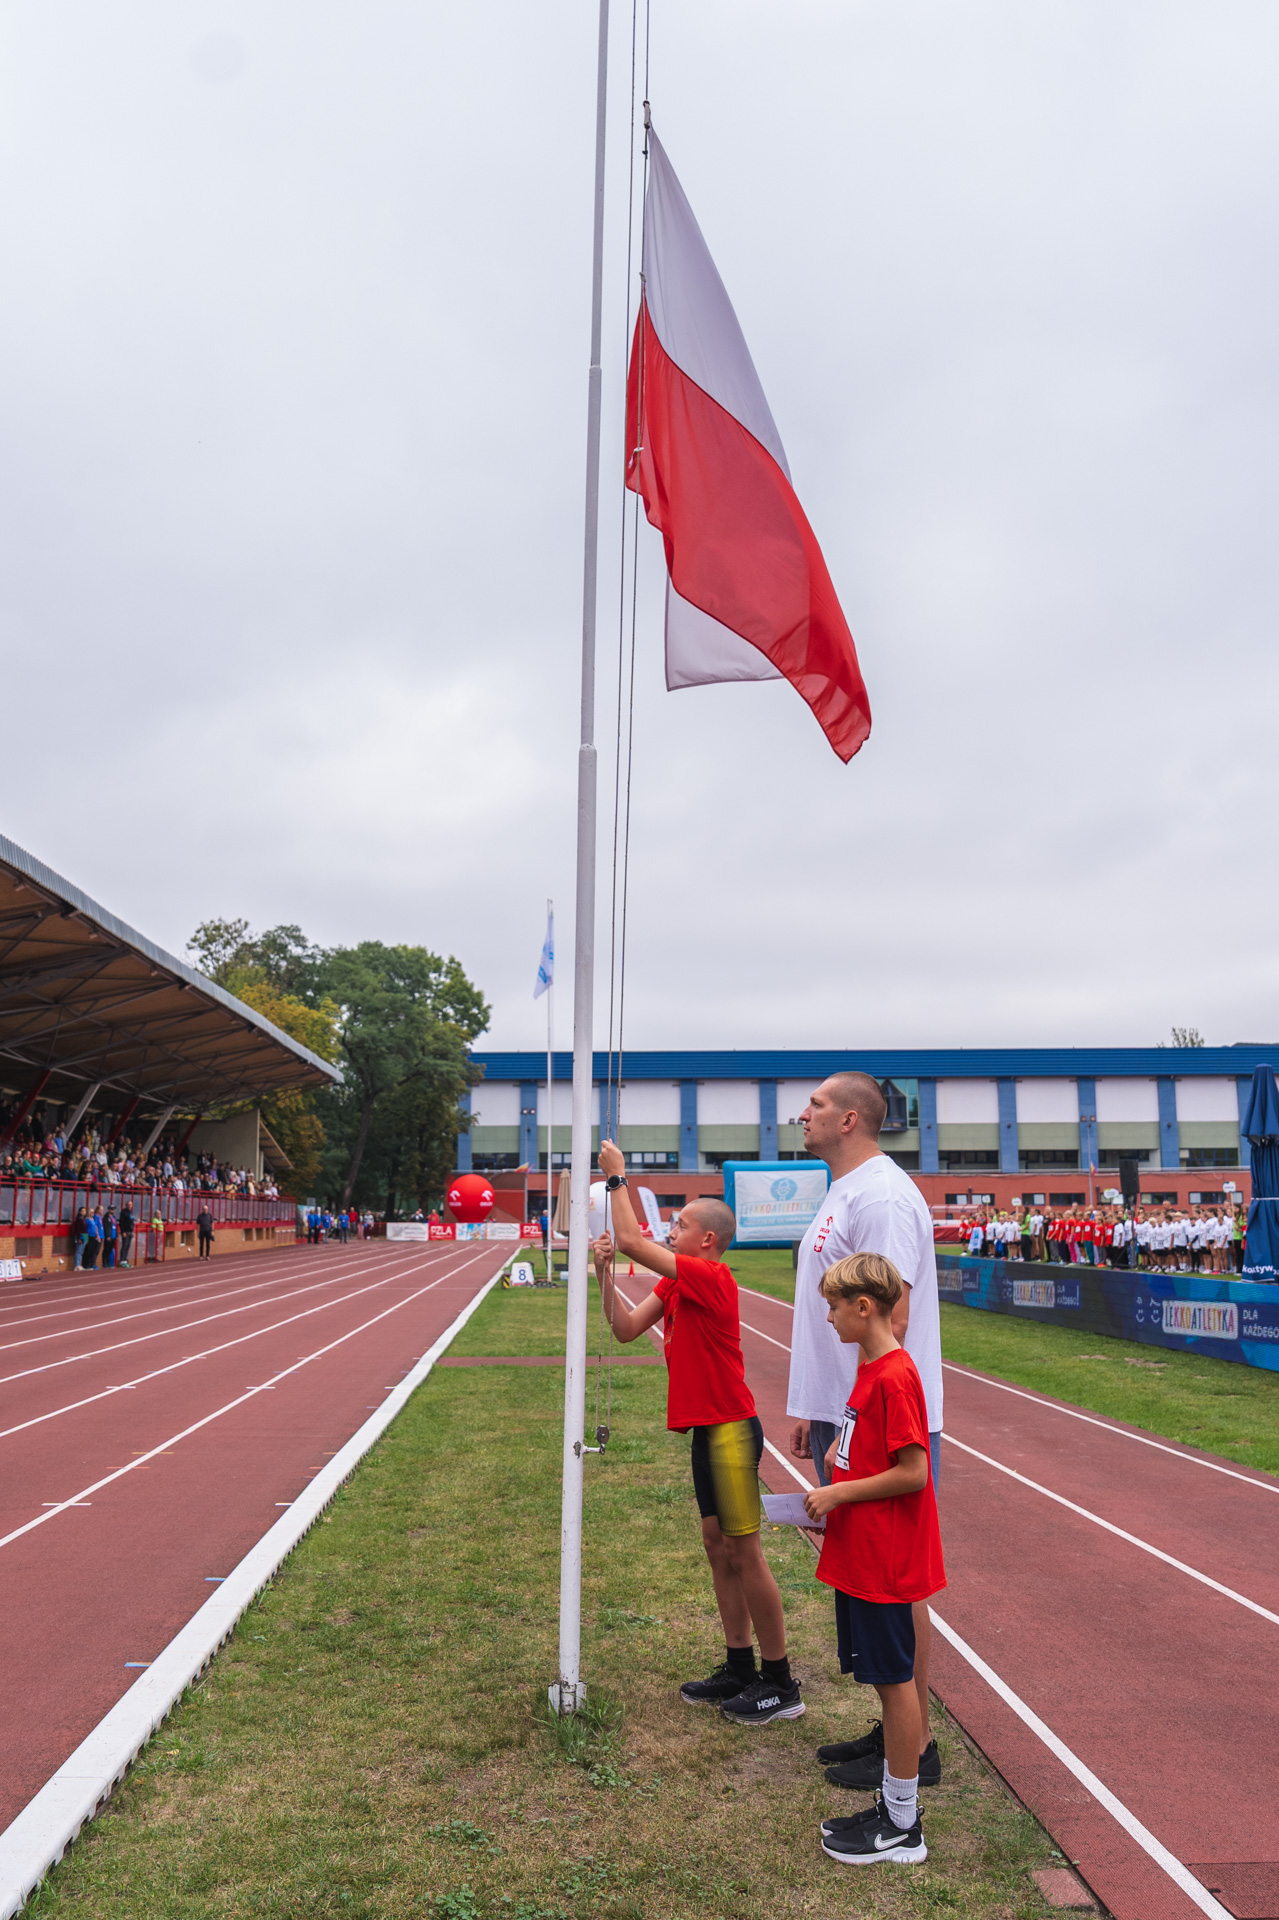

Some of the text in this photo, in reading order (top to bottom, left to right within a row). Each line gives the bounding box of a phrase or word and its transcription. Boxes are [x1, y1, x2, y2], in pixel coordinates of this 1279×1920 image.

[431, 1226, 453, 1235] PZLA
[523, 1226, 542, 1234] PZL
[519, 1269, 526, 1280] 8
[1165, 1306, 1235, 1332] LEKKOATLETYKA
[1243, 1309, 1258, 1320] DLA
[756, 1695, 781, 1710] HOKA
